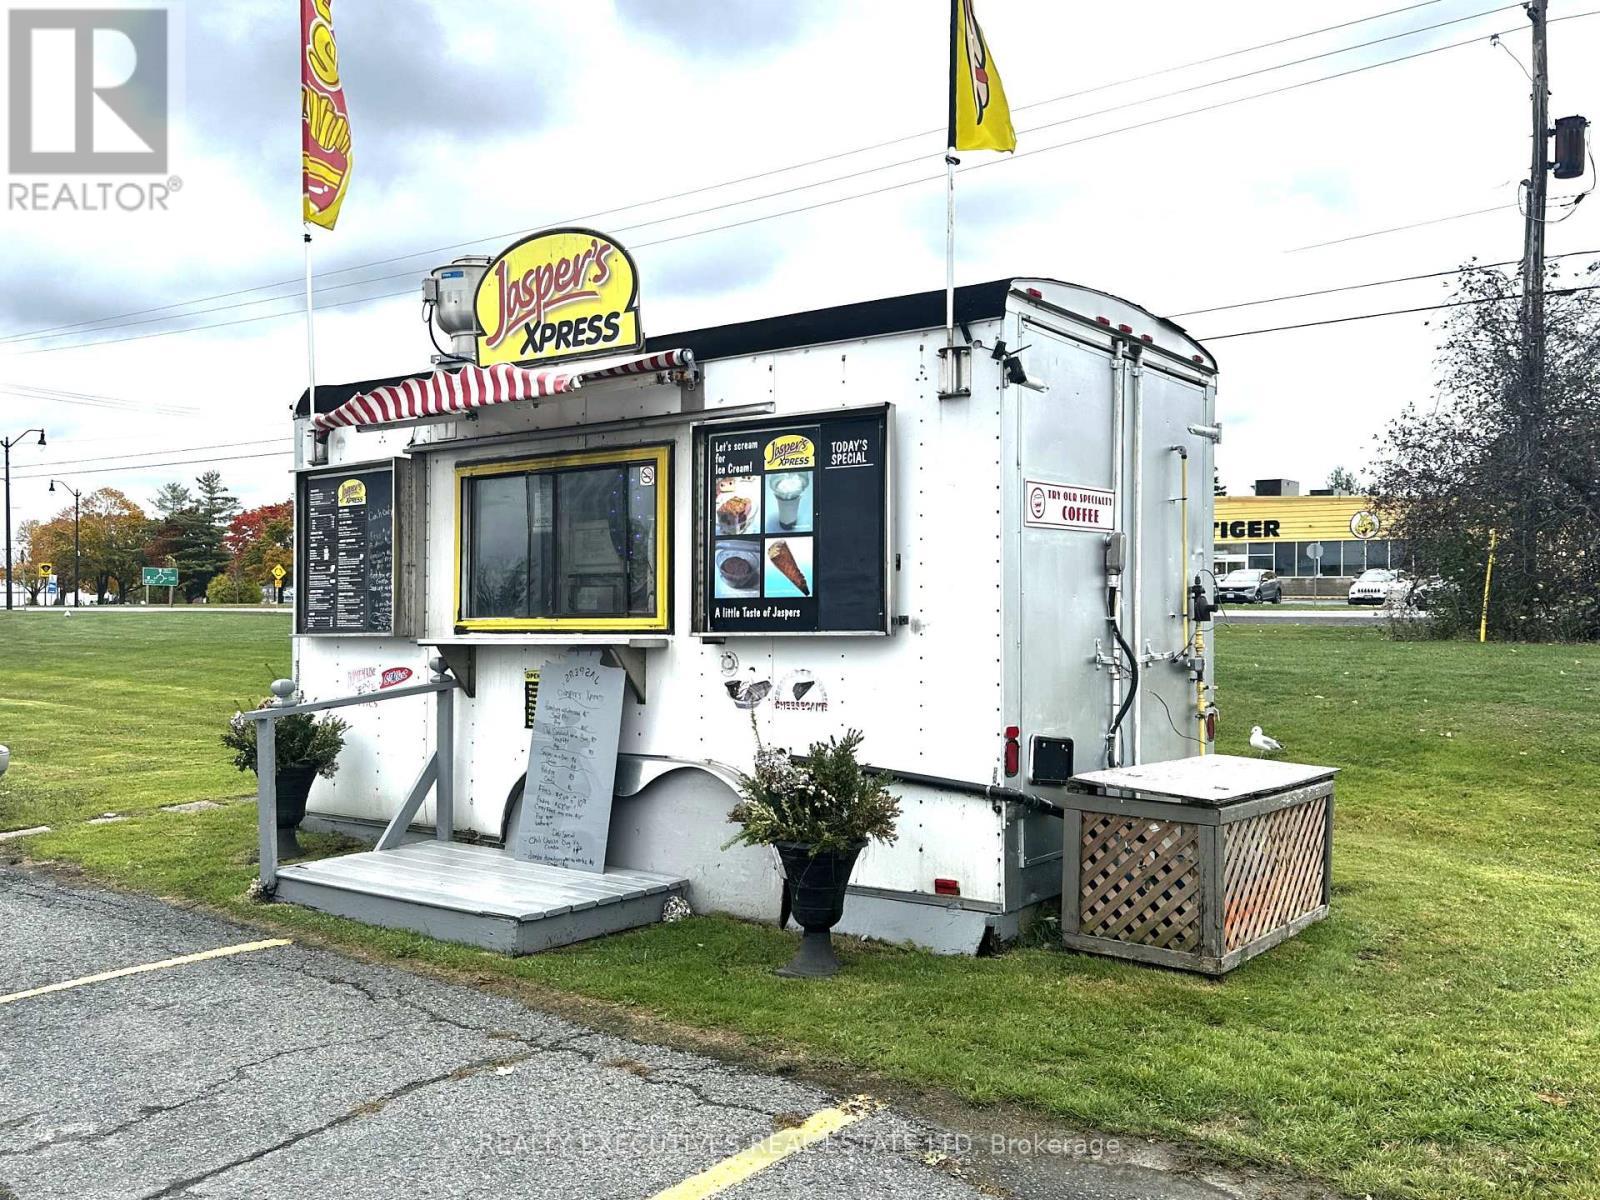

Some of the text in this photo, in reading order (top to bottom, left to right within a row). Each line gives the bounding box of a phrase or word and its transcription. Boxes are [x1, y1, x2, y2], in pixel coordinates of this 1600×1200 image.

[485, 238, 612, 347] Jasper's
[519, 310, 621, 355] XPRESS
[715, 440, 758, 453] Let's scream
[767, 438, 810, 466] Jasper's
[830, 439, 868, 453] TODAY'S
[715, 453, 726, 464] for
[778, 456, 810, 467] XPRESS
[830, 451, 867, 465] SPECIAL
[715, 461, 753, 475] Ice Cream!
[1047, 489, 1061, 500] TRY
[1079, 494, 1112, 506] SPECIALTY
[1062, 505, 1100, 523] COFFEE
[714, 606, 801, 620] A little Taste of Jaspers
